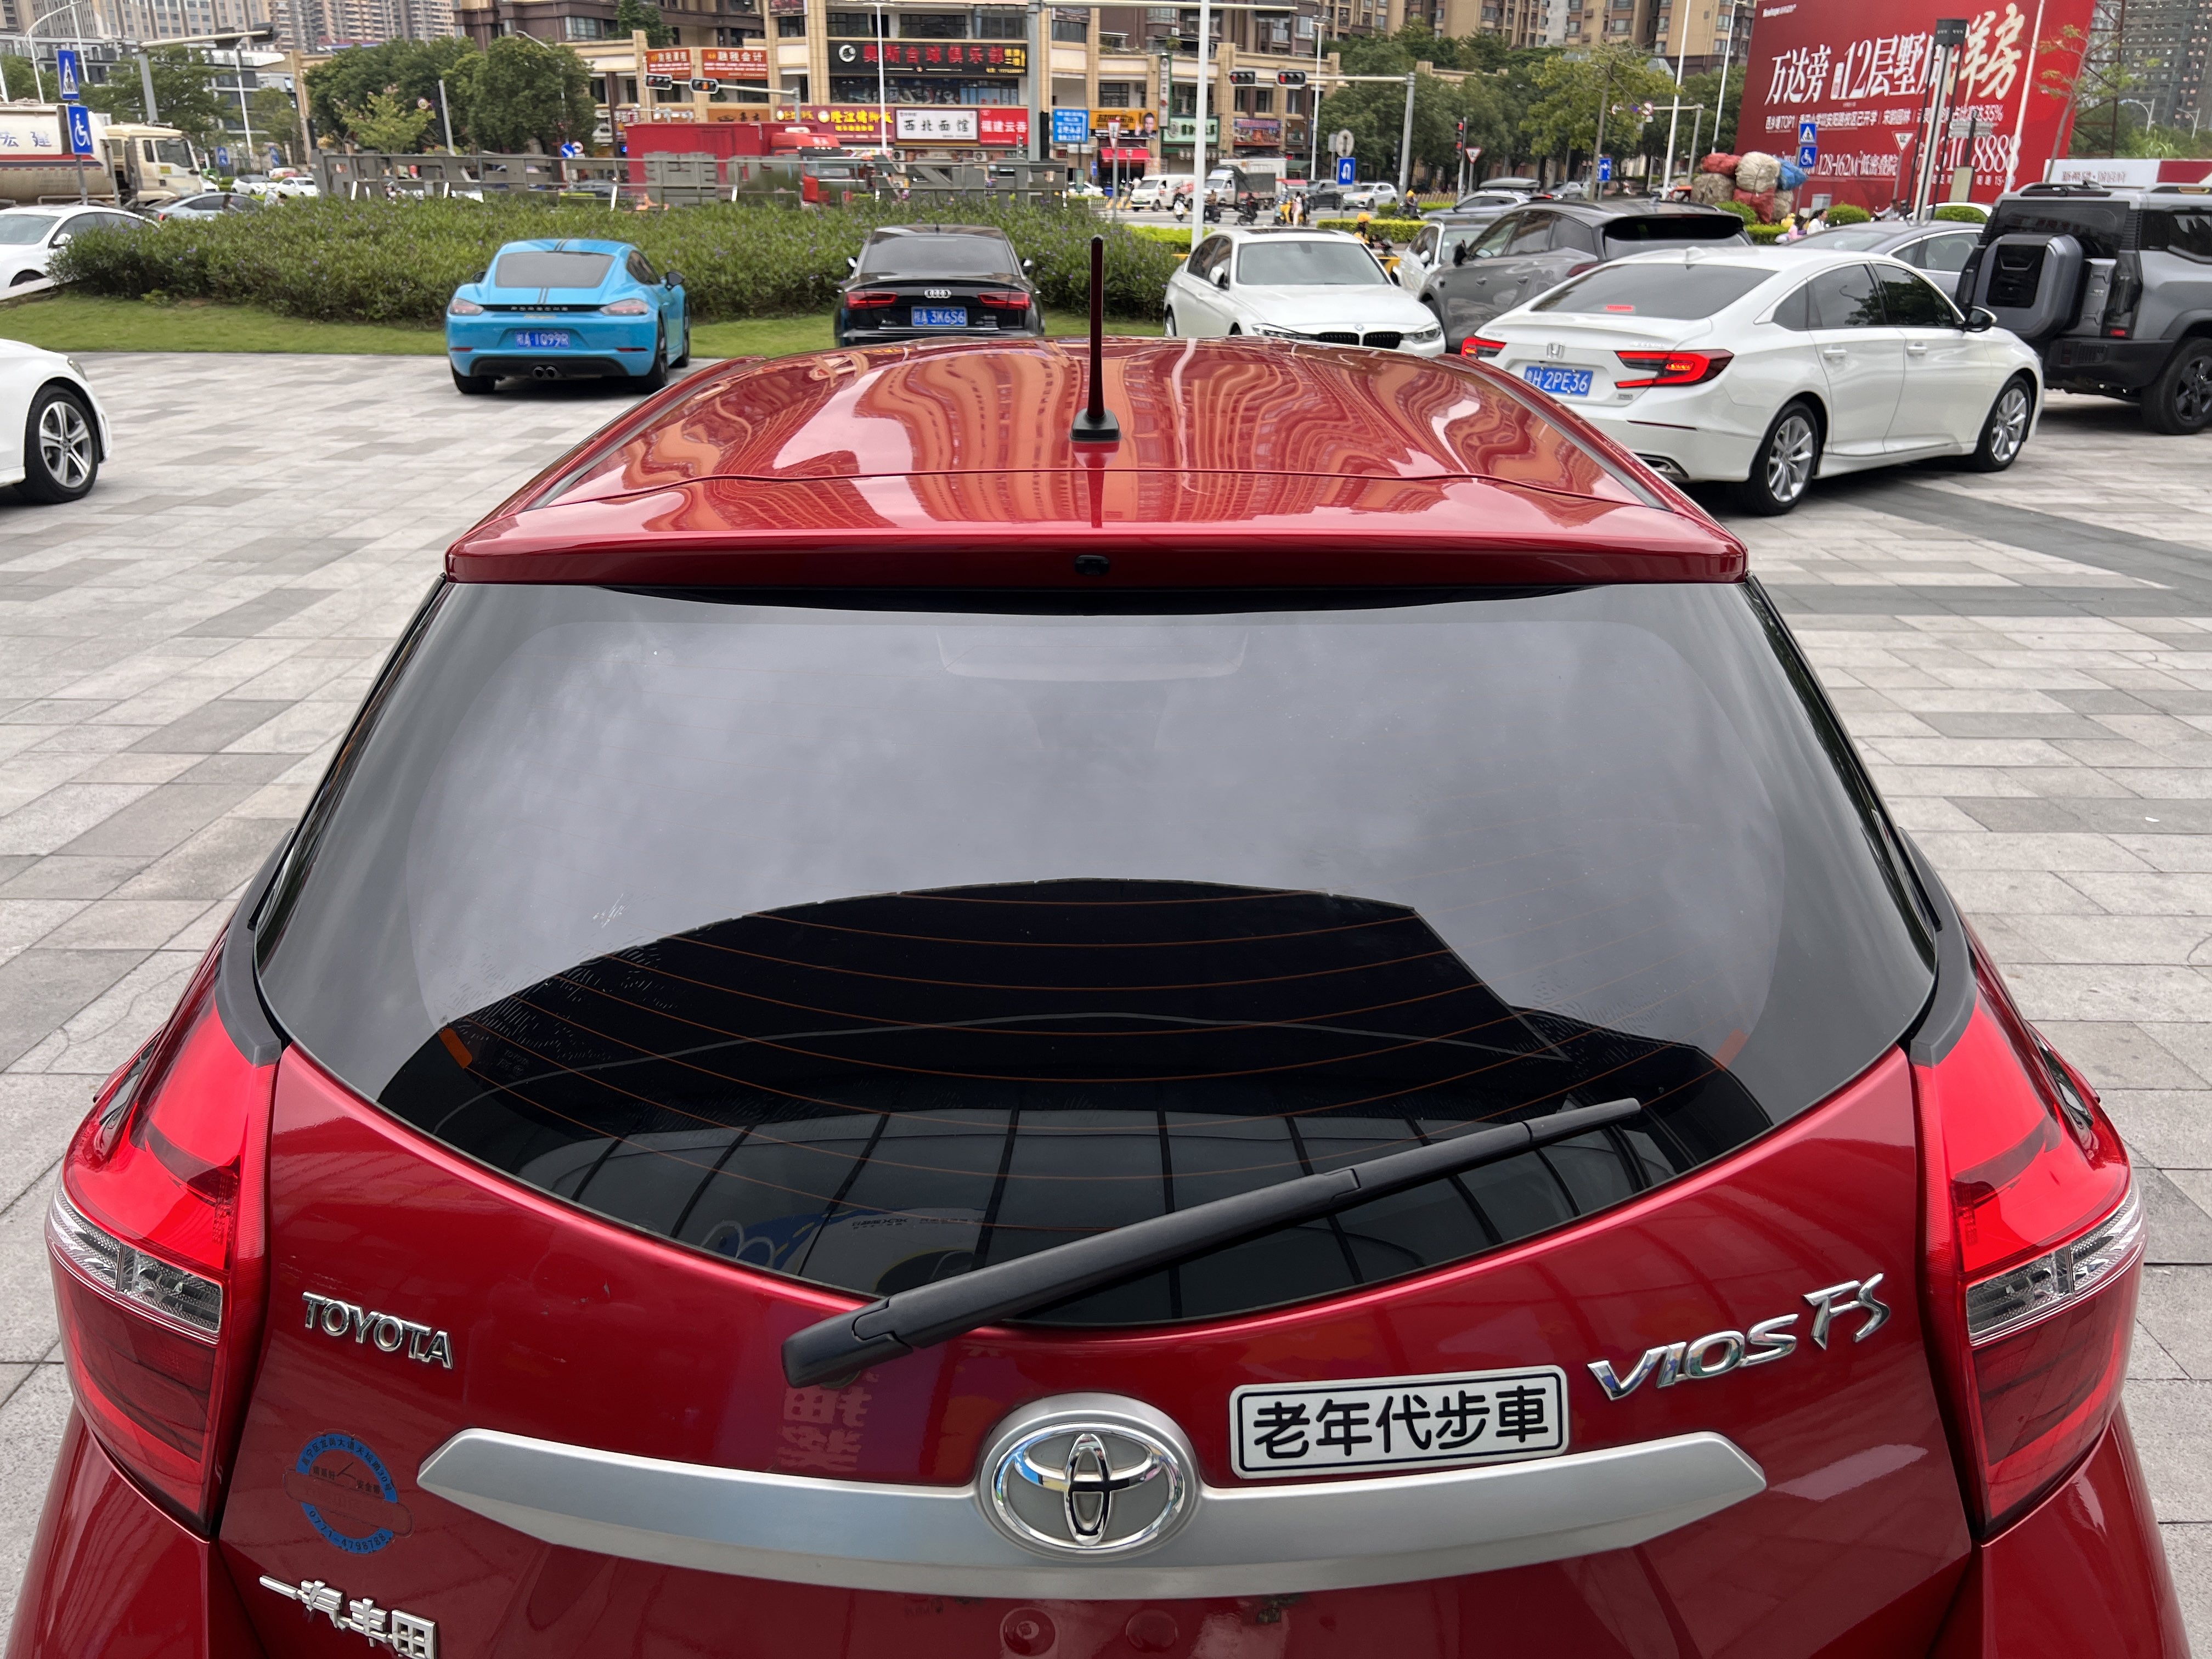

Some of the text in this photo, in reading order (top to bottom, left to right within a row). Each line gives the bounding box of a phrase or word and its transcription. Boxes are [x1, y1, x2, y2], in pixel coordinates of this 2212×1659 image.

[1764, 44, 1831, 106] 万达旁
[904, 119, 969, 132] 西北面馆
[981, 120, 1028, 133] 福建云吞
[302, 1291, 454, 1370] TOYOTA
[1587, 1272, 1891, 1402] VIOS FS
[1252, 1384, 1549, 1459] 老年代步車
[259, 1575, 437, 1659] 一汽丰田
